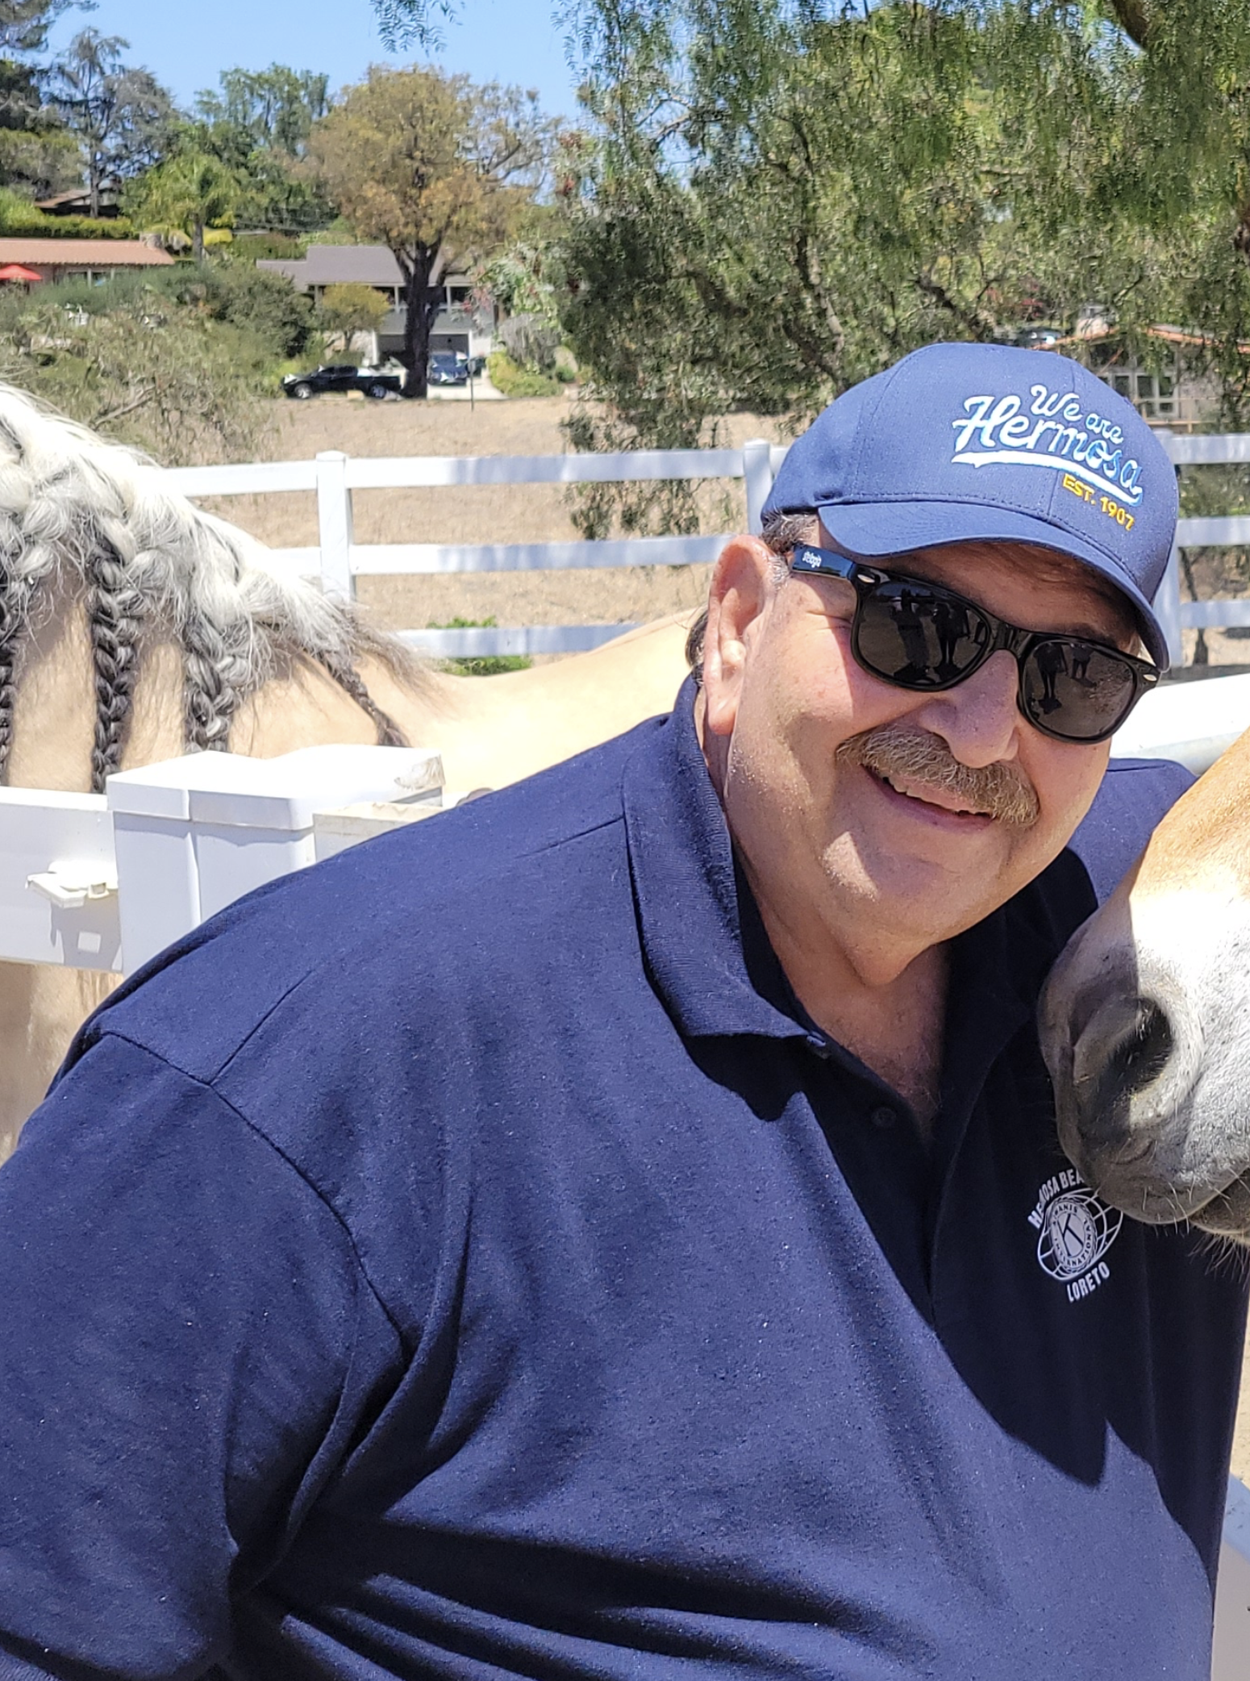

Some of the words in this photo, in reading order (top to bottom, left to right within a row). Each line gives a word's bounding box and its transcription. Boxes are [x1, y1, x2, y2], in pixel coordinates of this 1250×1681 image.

[1030, 384, 1083, 422] We
[1085, 413, 1124, 445] are
[952, 395, 1143, 496] Hermosa
[1062, 472, 1096, 505] EST.
[1100, 495, 1136, 531] 1907
[1027, 1176, 1060, 1230] HEOSA
[1058, 1168, 1085, 1190] BEA
[1066, 1261, 1110, 1303] LORETO
